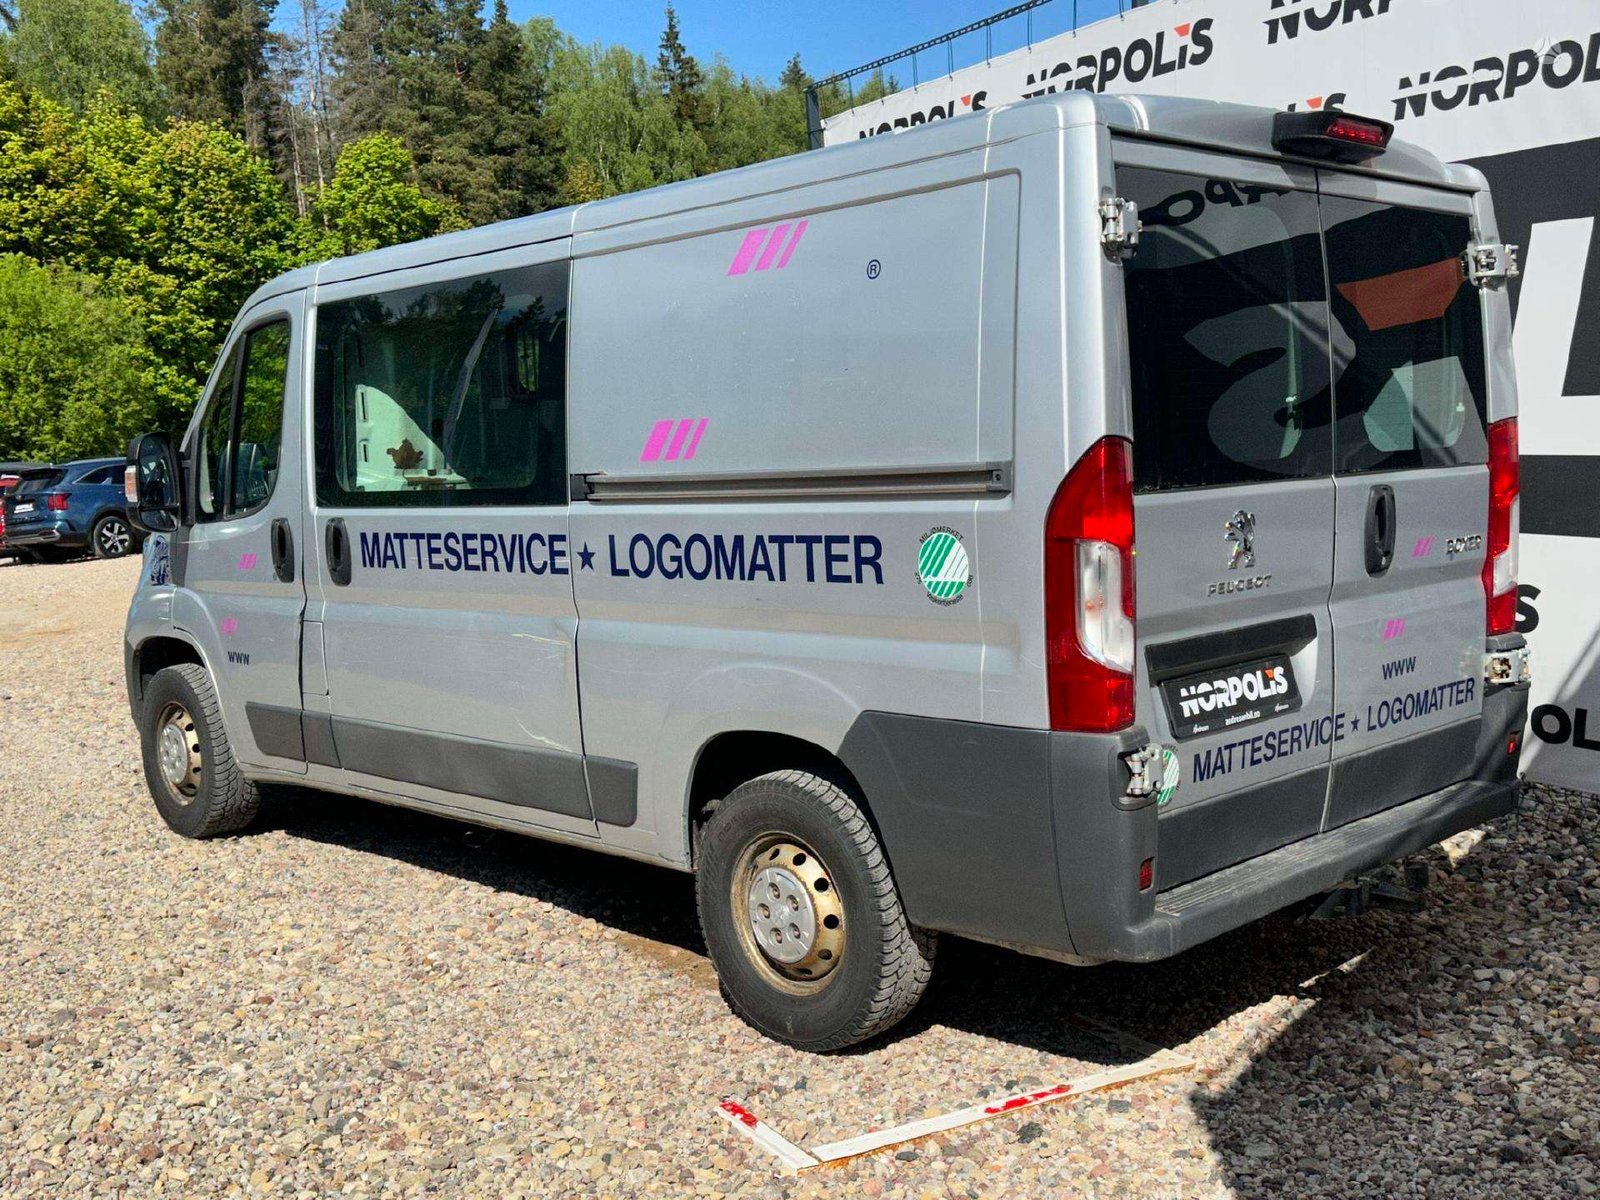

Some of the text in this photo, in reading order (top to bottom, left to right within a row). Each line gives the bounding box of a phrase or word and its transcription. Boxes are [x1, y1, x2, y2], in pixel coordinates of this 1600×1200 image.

[360, 532, 884, 584] MATTESERVICE LOGOMATTER
[1447, 535, 1481, 553] BOXER
[1207, 575, 1272, 597] PEUGEOT
[1193, 677, 1475, 783] MATTESERVICE LOGOMATTER
